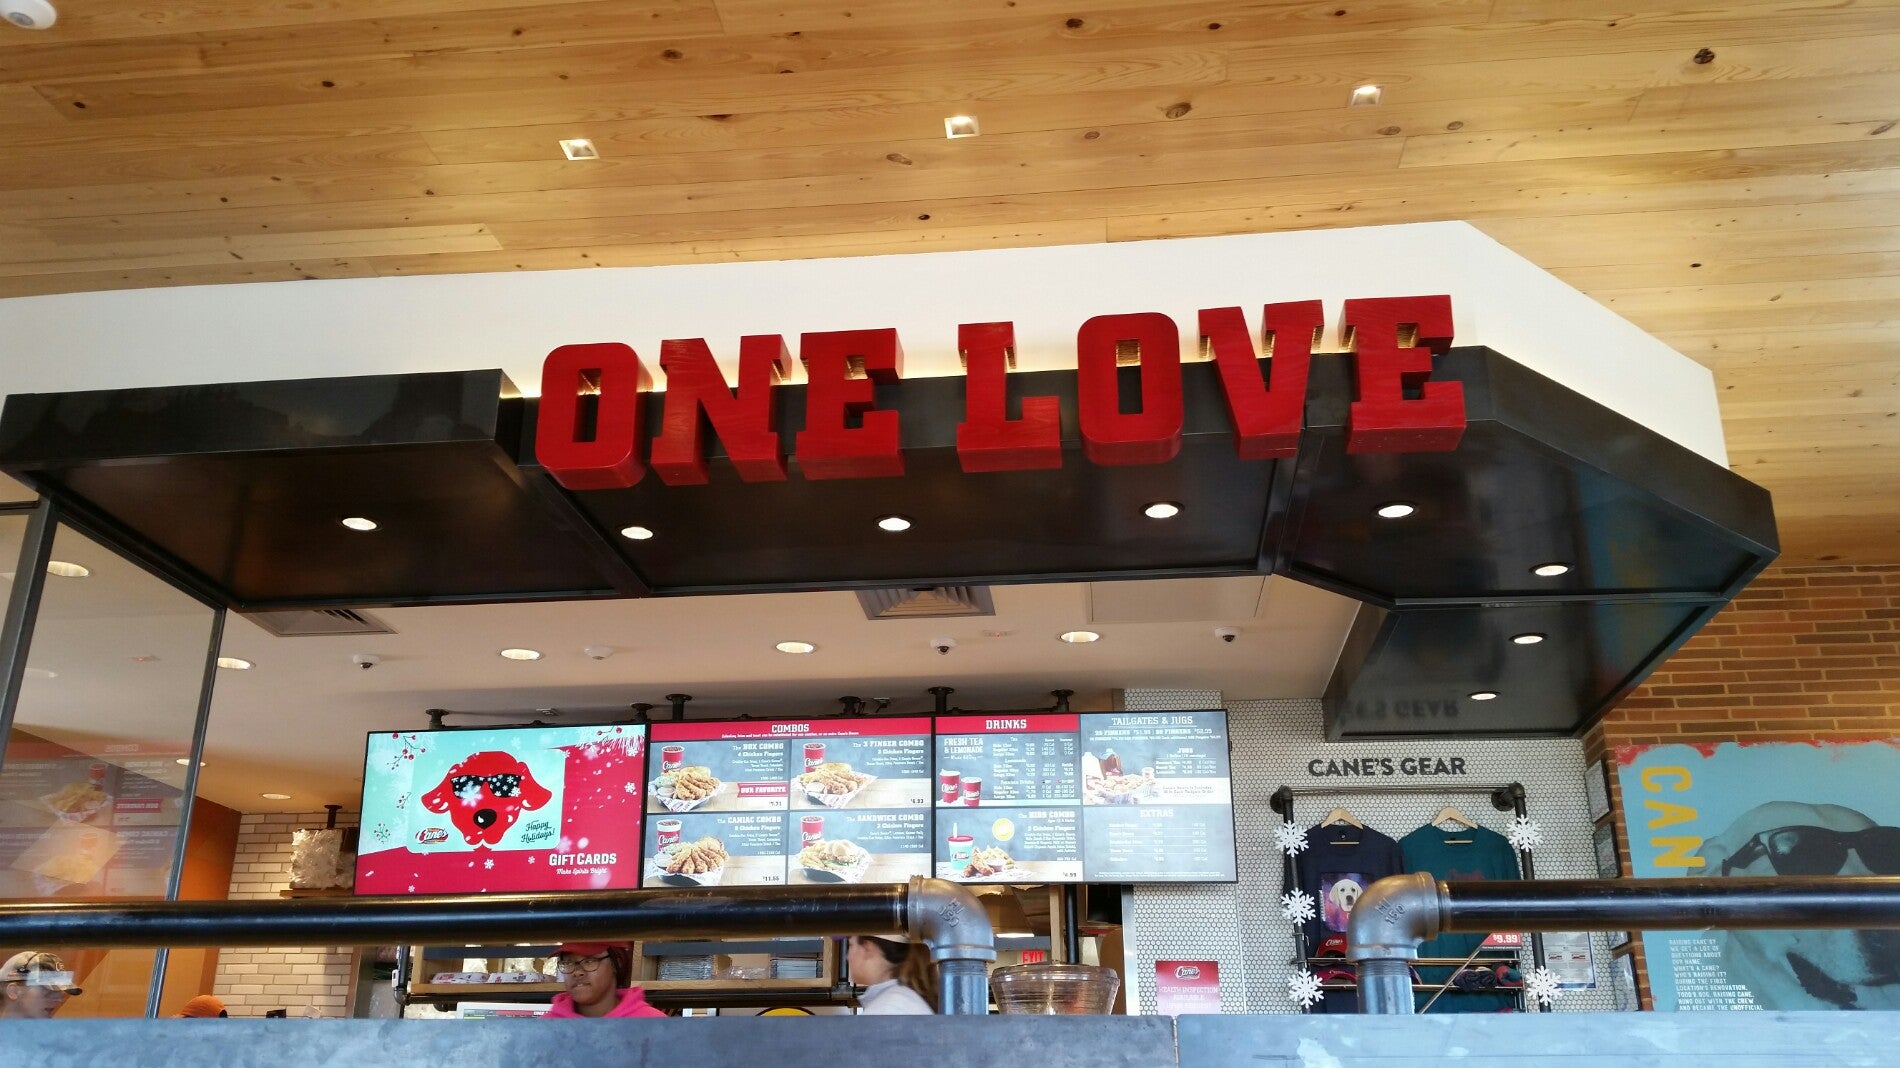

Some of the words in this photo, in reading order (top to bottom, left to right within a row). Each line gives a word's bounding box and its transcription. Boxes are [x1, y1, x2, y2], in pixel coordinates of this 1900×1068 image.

[536, 328, 904, 490] ONE
[957, 295, 1466, 472] LOVE
[985, 719, 1027, 730] DRINKS
[1111, 717, 1159, 726] TAILGATES
[1162, 716, 1168, 725] &
[1170, 716, 1193, 725] JUGS
[771, 723, 809, 734] COMBOS
[944, 737, 968, 746] FRESH
[969, 737, 984, 745] TEA
[951, 746, 984, 754] LEMONADE
[1308, 757, 1395, 778] CANE'S
[1401, 757, 1467, 777] GEAR
[898, 813, 924, 821] COMBO
[1140, 809, 1174, 818] EXTRAS
[1640, 765, 1706, 870] CAN
[526, 820, 552, 834] Happy
[417, 828, 449, 845] Cane's
[520, 827, 556, 844] Holidays!
[549, 854, 576, 867] GIFT
[577, 852, 617, 866] CARDS
[589, 867, 608, 875] Bright
[1385, 904, 1406, 925] 150
[1493, 934, 1518, 944] $9.99
[1021, 950, 1045, 964] EXIT
